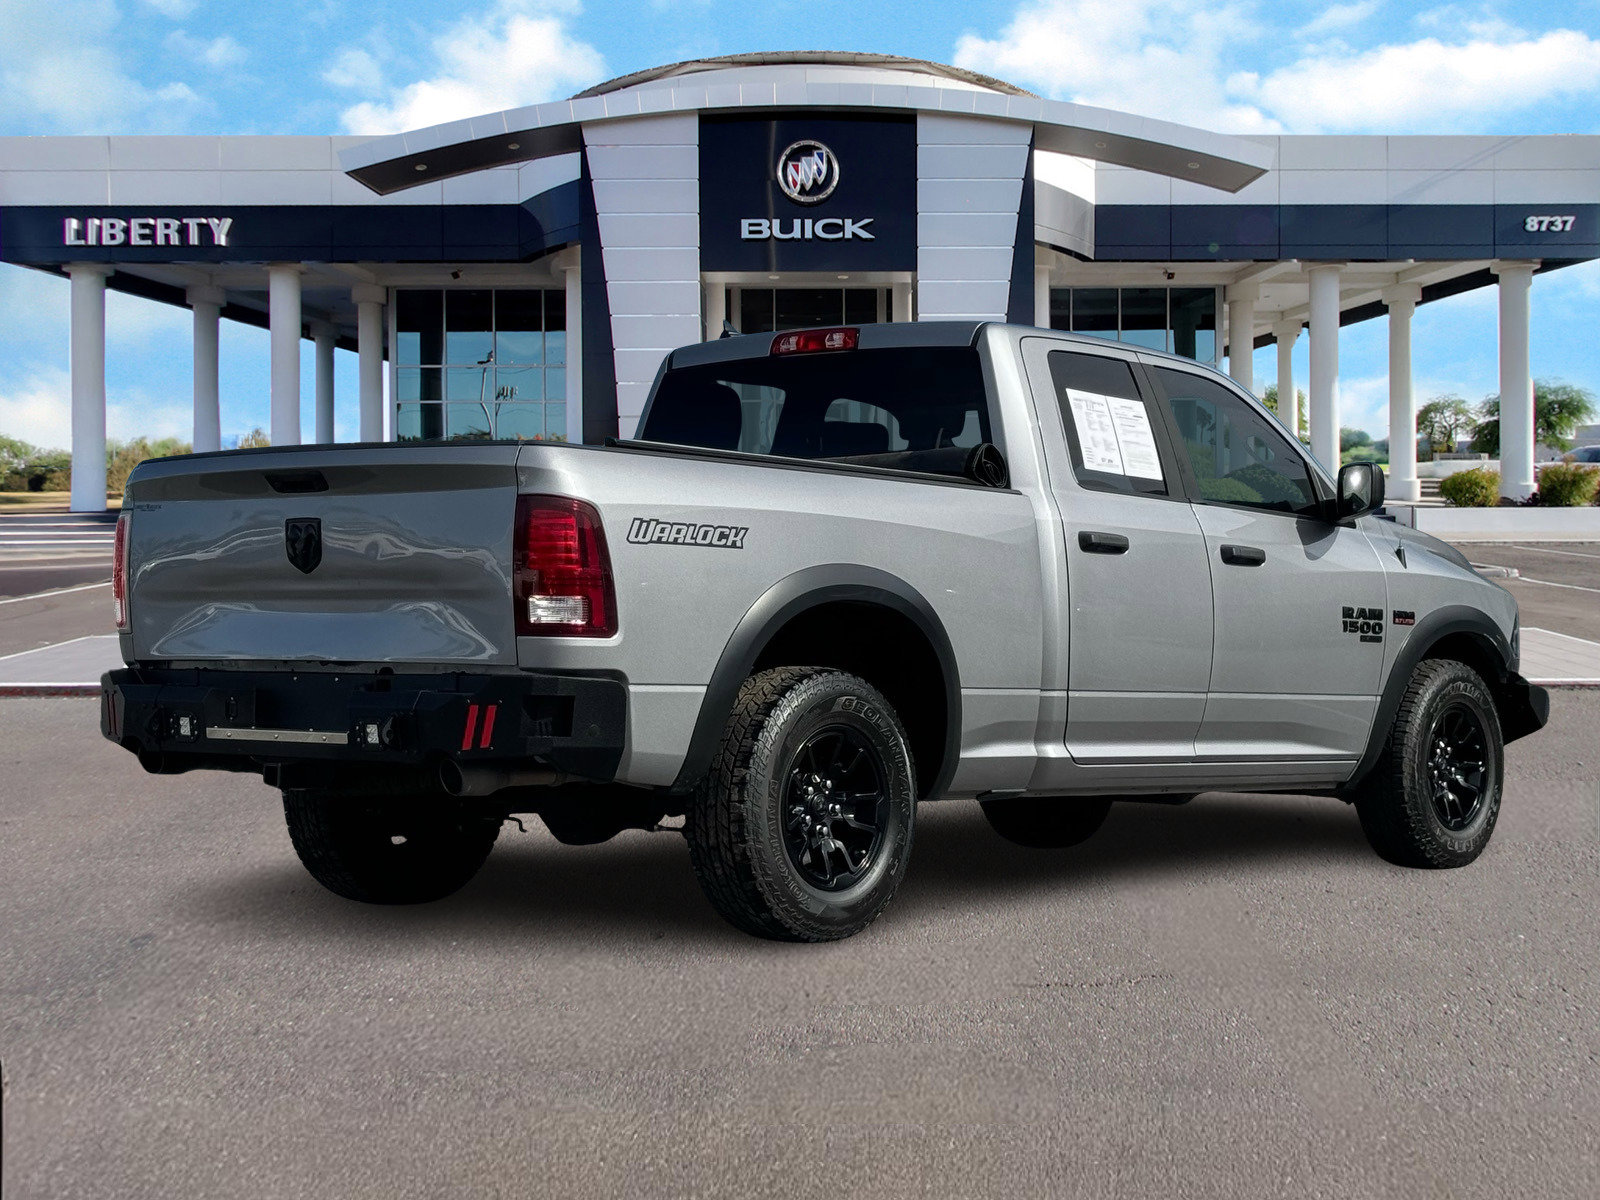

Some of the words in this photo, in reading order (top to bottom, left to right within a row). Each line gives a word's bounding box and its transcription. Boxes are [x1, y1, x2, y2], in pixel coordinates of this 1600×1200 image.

[64, 217, 233, 246] LIBERTY
[741, 218, 875, 239] BUICK
[1525, 215, 1576, 232] 8737
[626, 517, 749, 549] WARLOCK
[1342, 606, 1383, 621] RAM
[1342, 620, 1383, 635] 1500
